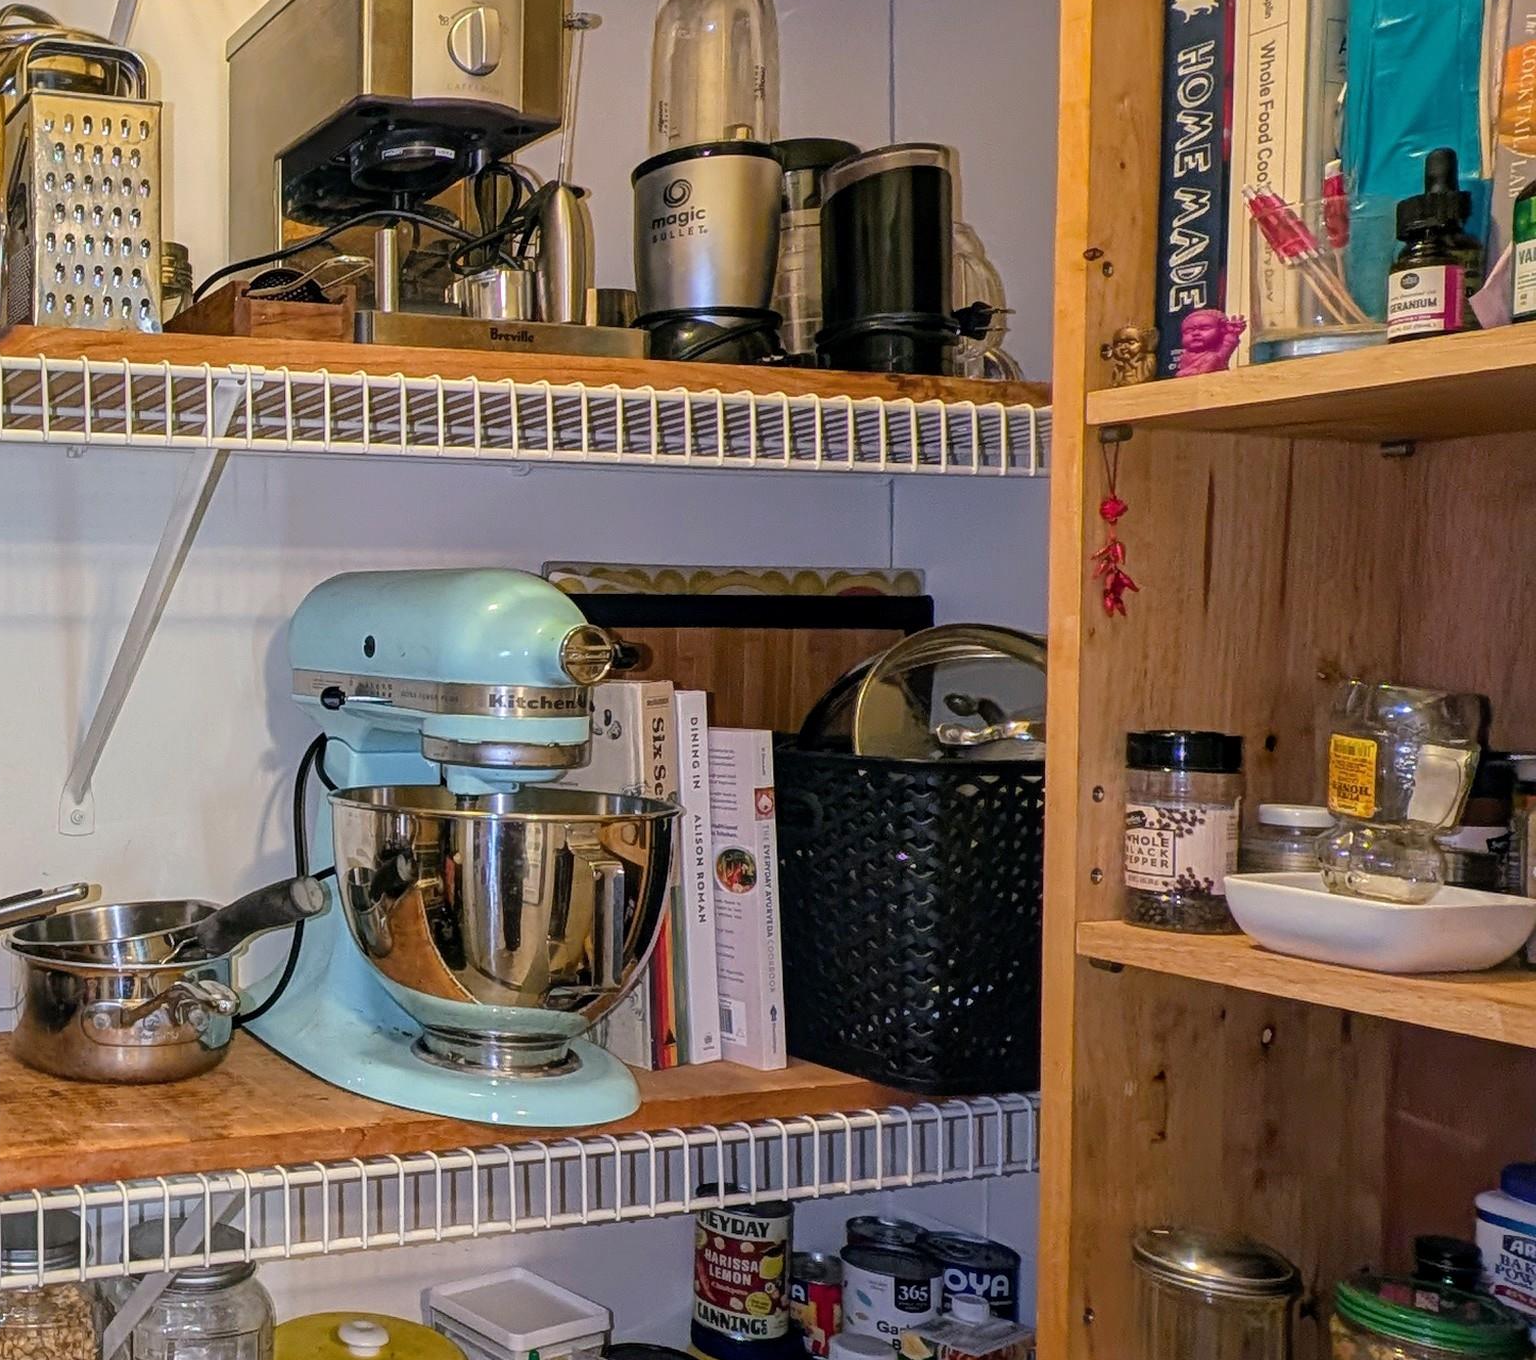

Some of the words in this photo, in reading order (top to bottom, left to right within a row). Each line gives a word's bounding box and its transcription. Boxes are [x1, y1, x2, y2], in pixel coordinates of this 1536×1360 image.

[1258, 40, 1276, 97] Whole
[1174, 40, 1216, 178] HOME
[1512, 44, 1536, 154] COCKTAIL
[1257, 99, 1275, 144] Food
[652, 206, 707, 230] magic
[1168, 186, 1212, 313] MADE
[1390, 297, 1438, 314] GERANIUM
[490, 327, 534, 344] Breville
[651, 717, 667, 760] Six
[690, 717, 701, 770] DINING
[693, 779, 701, 790] IN
[693, 815, 705, 868] ALISON
[1126, 846, 1169, 859] LACK
[1126, 854, 1169, 869] EPPER
[696, 871, 707, 924] ROMAN
[704, 1248, 760, 1274] HARISSA
[1509, 1240, 1536, 1259] AR
[709, 1264, 752, 1287] LEMON
[1495, 1263, 1534, 1285] POW
[1499, 1253, 1536, 1275] BAK
[898, 1285, 929, 1301] 365
[943, 1268, 1010, 1297] OYA
